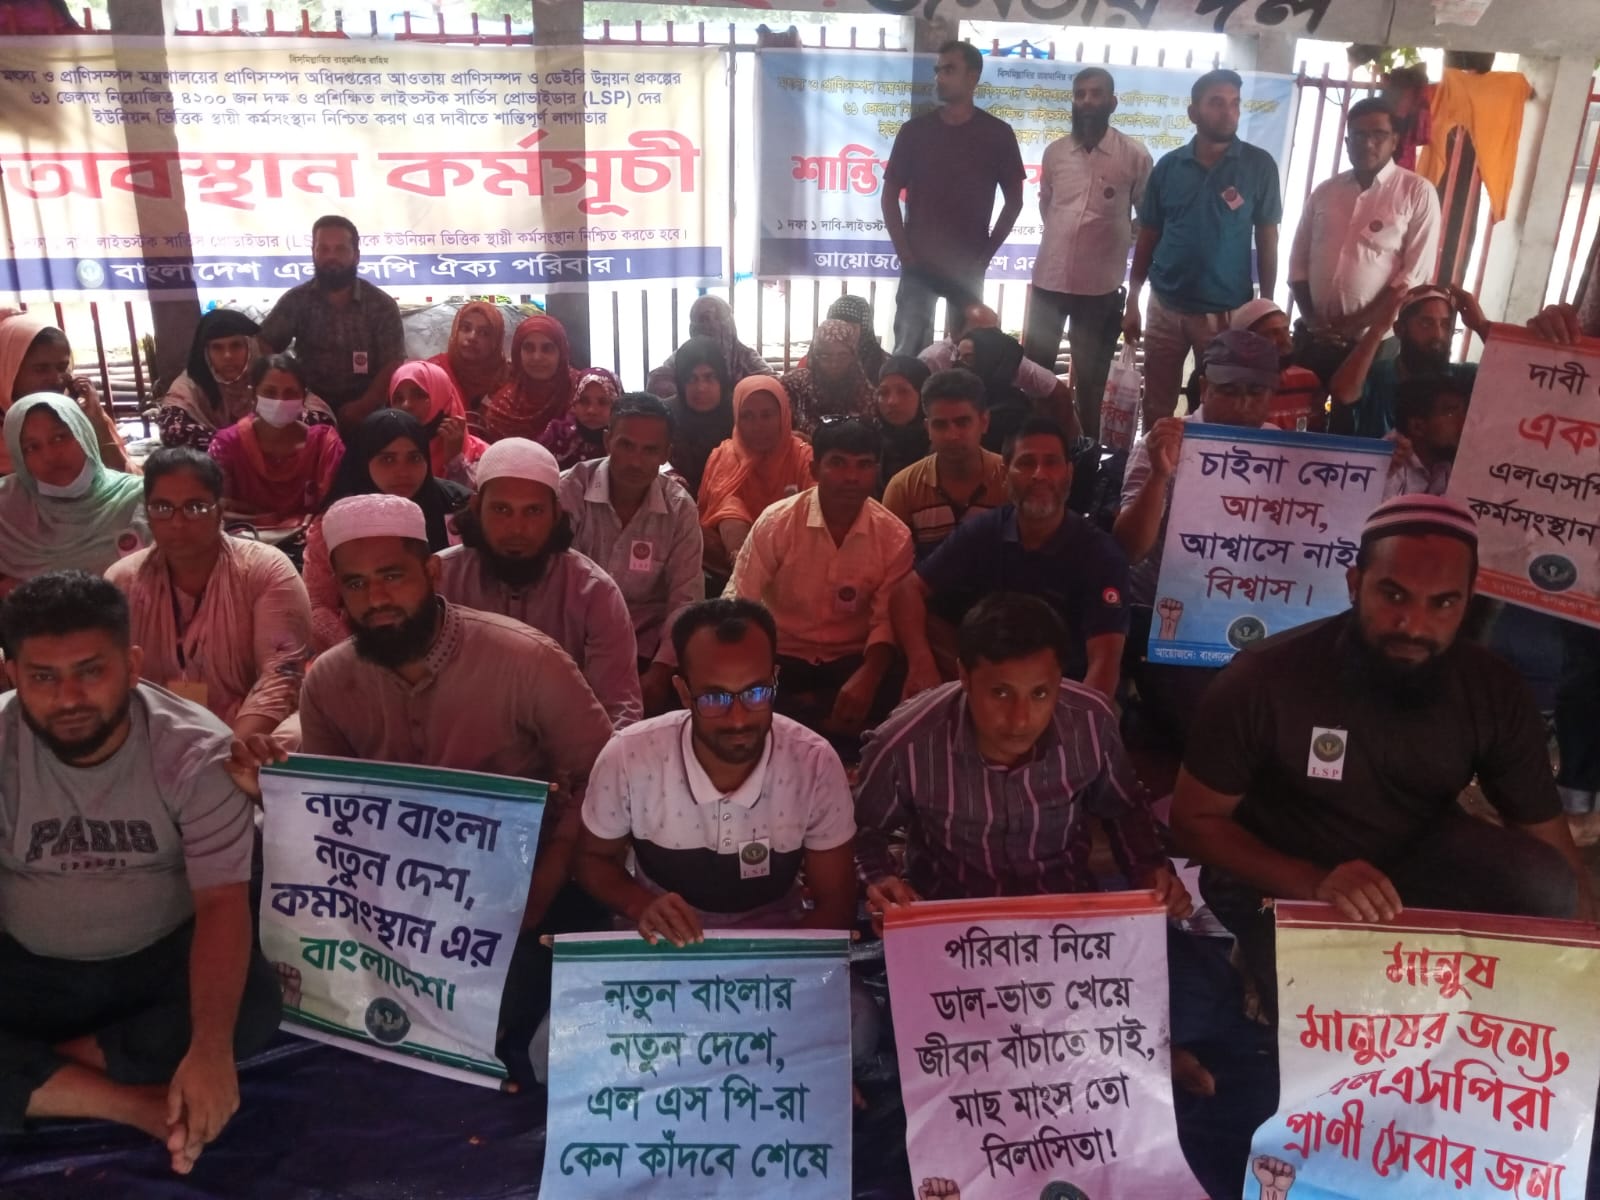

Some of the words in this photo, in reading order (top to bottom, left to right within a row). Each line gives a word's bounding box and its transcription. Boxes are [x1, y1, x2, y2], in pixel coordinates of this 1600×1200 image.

[43, 71, 54, 82] ও
[60, 66, 132, 84] প্রাণিসম্পদ
[224, 67, 299, 85] প্রাণিসম্পদ
[304, 68, 381, 85] অধিদপ্তরের
[386, 71, 445, 85] আওতায়
[451, 69, 521, 86] প্রাণিসম্পদ
[528, 72, 539, 84] ও
[545, 68, 585, 85] ডেইরি
[591, 68, 630, 87] উন্নয়ন
[634, 72, 681, 86] প্রকল্পের
[57, 91, 101, 105] জেলায়
[105, 87, 173, 104] নিয়োজিত
[181, 93, 226, 105] ৪২০০
[232, 93, 257, 105] জন
[263, 93, 289, 105] দক্ষ
[296, 95, 308, 104] ও
[313, 89, 374, 105] প্রশিক্ষিত
[380, 90, 449, 105] লাইভস্টক
[454, 88, 497, 104] সার্ভিস
[503, 90, 577, 104] প্রোভাইডার
[582, 90, 632, 108] (LSP)
[637, 93, 662, 104] দের
[92, 109, 151, 125] ইউনিয়ন
[155, 108, 203, 125] ভিত্তিক
[246, 109, 316, 128] কর্মসংস্থান
[321, 109, 369, 125] নিশ্চিত
[373, 112, 407, 125] করণ
[413, 112, 435, 125] এর
[440, 108, 488, 126] দাবীতে
[493, 108, 547, 128] শান্তিপূর্ণ
[552, 111, 607, 125] লাগাতার
[1, 151, 359, 211] অবস্থান
[378, 130, 701, 215] কর্মসূচী
[441, 230, 480, 246] ভিত্তিক
[484, 229, 512, 247] স্থায়ী
[517, 228, 574, 247] কর্মসংস্থান
[578, 227, 617, 242] নিশ্চিত
[622, 229, 655, 241] করতে
[111, 260, 261, 284] বাংলাদেশ
[431, 255, 501, 278] ঐক্য
[511, 253, 615, 277] পরিবার
[1529, 361, 1590, 396] দাবী
[1199, 445, 1289, 485] চাইনা
[1298, 460, 1376, 492] কোন
[1220, 495, 1329, 533] আশ্বাস,
[1467, 497, 1599, 547] কর্মসংস্থান
[1179, 532, 1295, 564] আশ্বাসে
[1205, 566, 1296, 605] বিশ্বাস
[25, 815, 159, 863] PARIS
[302, 792, 392, 837] নতুন
[397, 800, 501, 852] বাংলা
[314, 834, 390, 889] নতুন
[396, 858, 475, 911] দেশ,
[271, 874, 436, 954] কর্মসংস্থান
[440, 925, 502, 967] এর
[945, 926, 1041, 969] পরিবার
[1048, 924, 1115, 963] নিয়ে
[1382, 941, 1500, 1001] মানুষ
[602, 979, 682, 1024] নতুন
[689, 974, 796, 1015] বাংলার
[930, 980, 1055, 1022] ডাল-ভাত
[1066, 974, 1134, 1010] খেয়ে
[607, 1032, 687, 1077] নতুন
[698, 1027, 785, 1074] দেশে,
[915, 1032, 992, 1078] জীবন
[998, 1024, 1088, 1069] বাঁচাতে
[1095, 1016, 1156, 1063] চাই,
[1296, 1003, 1449, 1066] মানুষের
[1457, 1010, 1570, 1083] জন্য,
[588, 1086, 645, 1122] এল
[656, 1086, 712, 1122] এস
[720, 1073, 810, 1124] পি-রা
[949, 1088, 1007, 1128] মাছ
[1008, 1081, 1073, 1120] মাংস
[1086, 1071, 1130, 1114] তো
[560, 1142, 630, 1179] কেন
[635, 1129, 741, 1180] কাঁদবে
[752, 1138, 834, 1180] শেষে
[981, 1125, 1117, 1179] বিলাসিতা!
[1283, 1098, 1365, 1160] প্রাণী
[1373, 1119, 1476, 1190] সেবার
[1484, 1148, 1566, 1200] জন্য
